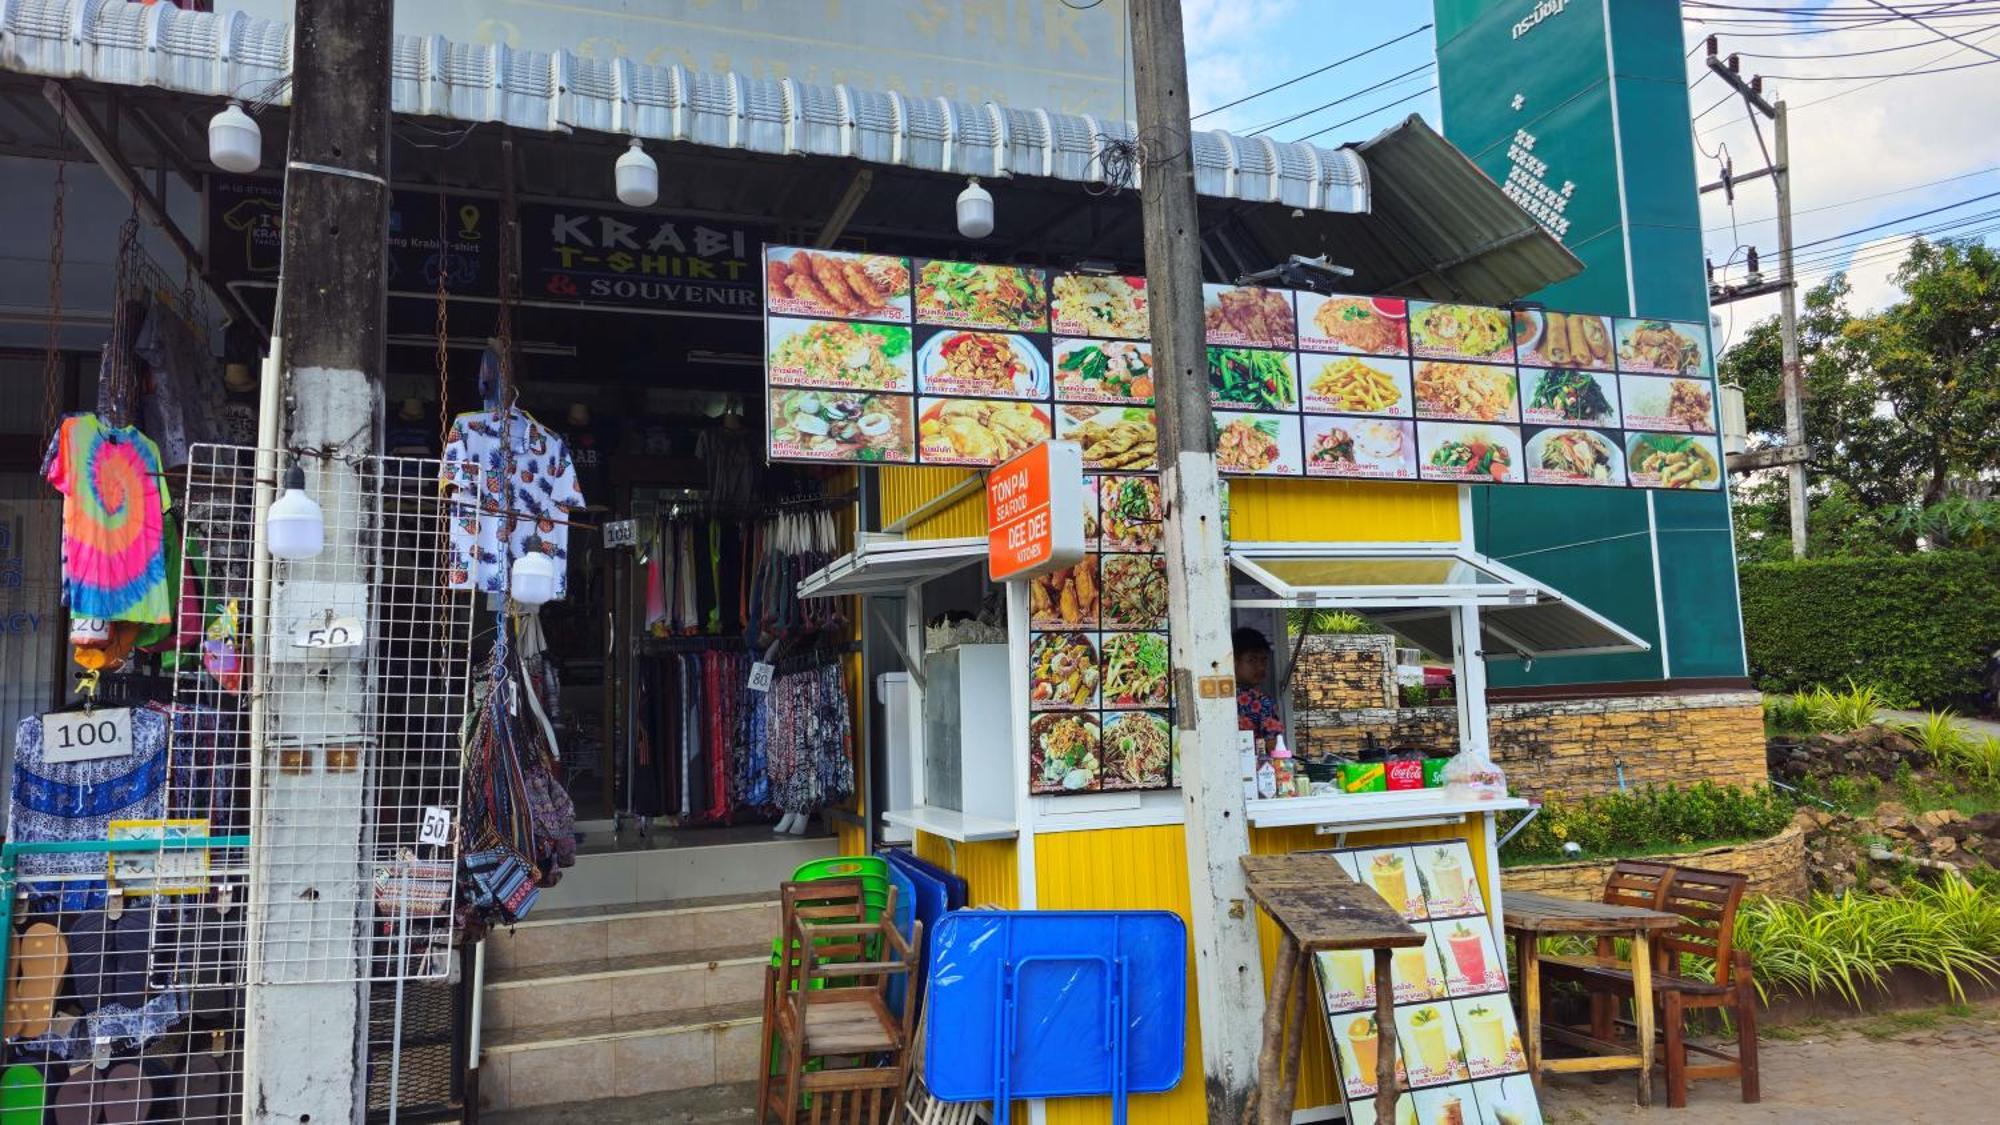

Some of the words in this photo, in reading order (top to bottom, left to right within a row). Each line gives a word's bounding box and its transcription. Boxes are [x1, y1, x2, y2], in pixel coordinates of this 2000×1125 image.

[551, 213, 746, 259] KRABI
[553, 246, 748, 281] T-SHIRT
[991, 467, 1029, 506] TONPAI
[996, 493, 1028, 523] SEAFOOD
[1008, 521, 1026, 550] DEE
[1027, 511, 1048, 542] DEE
[1390, 765, 1422, 780] Coca-Cola
